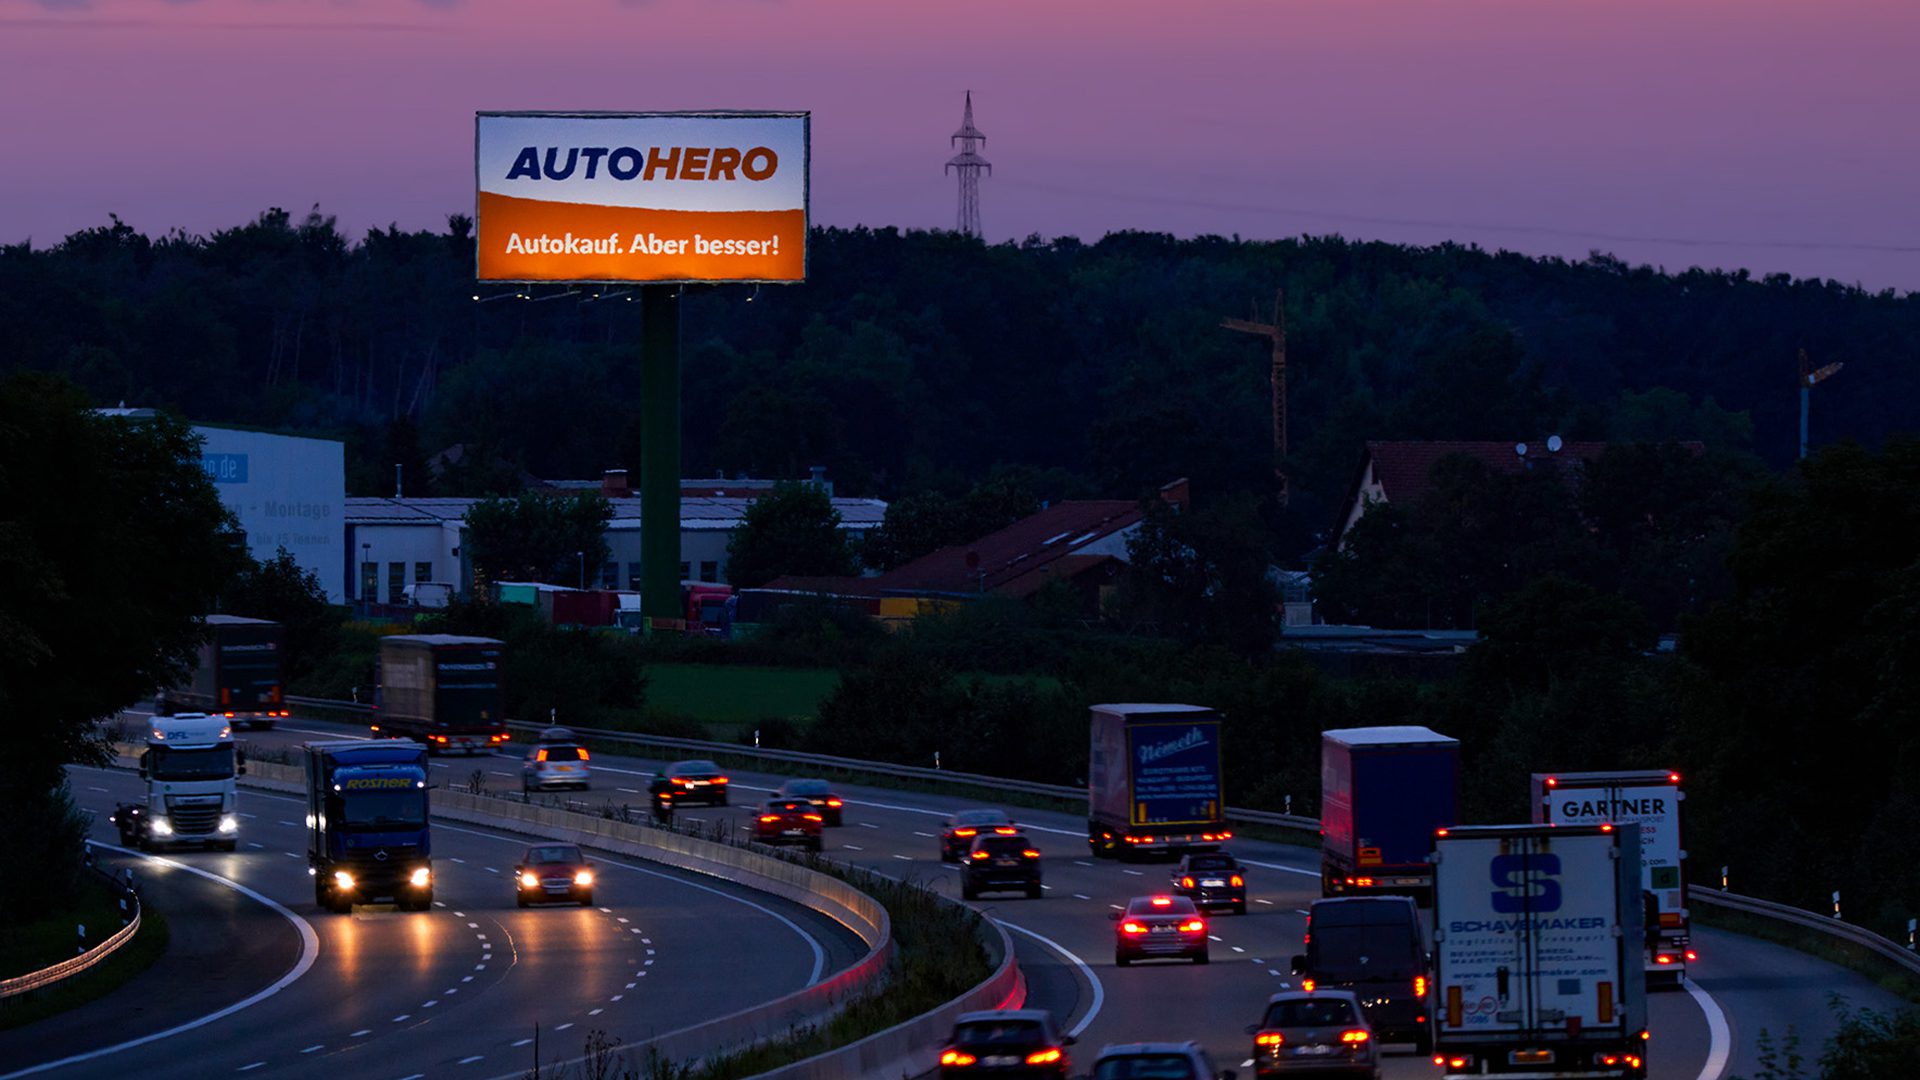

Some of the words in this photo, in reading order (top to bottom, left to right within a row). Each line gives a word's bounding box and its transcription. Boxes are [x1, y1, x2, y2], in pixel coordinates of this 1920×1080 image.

[505, 146, 778, 181] AUTOHERO
[505, 232, 623, 255] Autokauf.
[629, 233, 689, 255] Aber
[694, 233, 779, 255] besser!
[264, 501, 330, 520] Montage
[1562, 799, 1666, 817] GARTNER
[1490, 853, 1562, 913] S
[1450, 918, 1606, 932] SCHAVEMAKER
